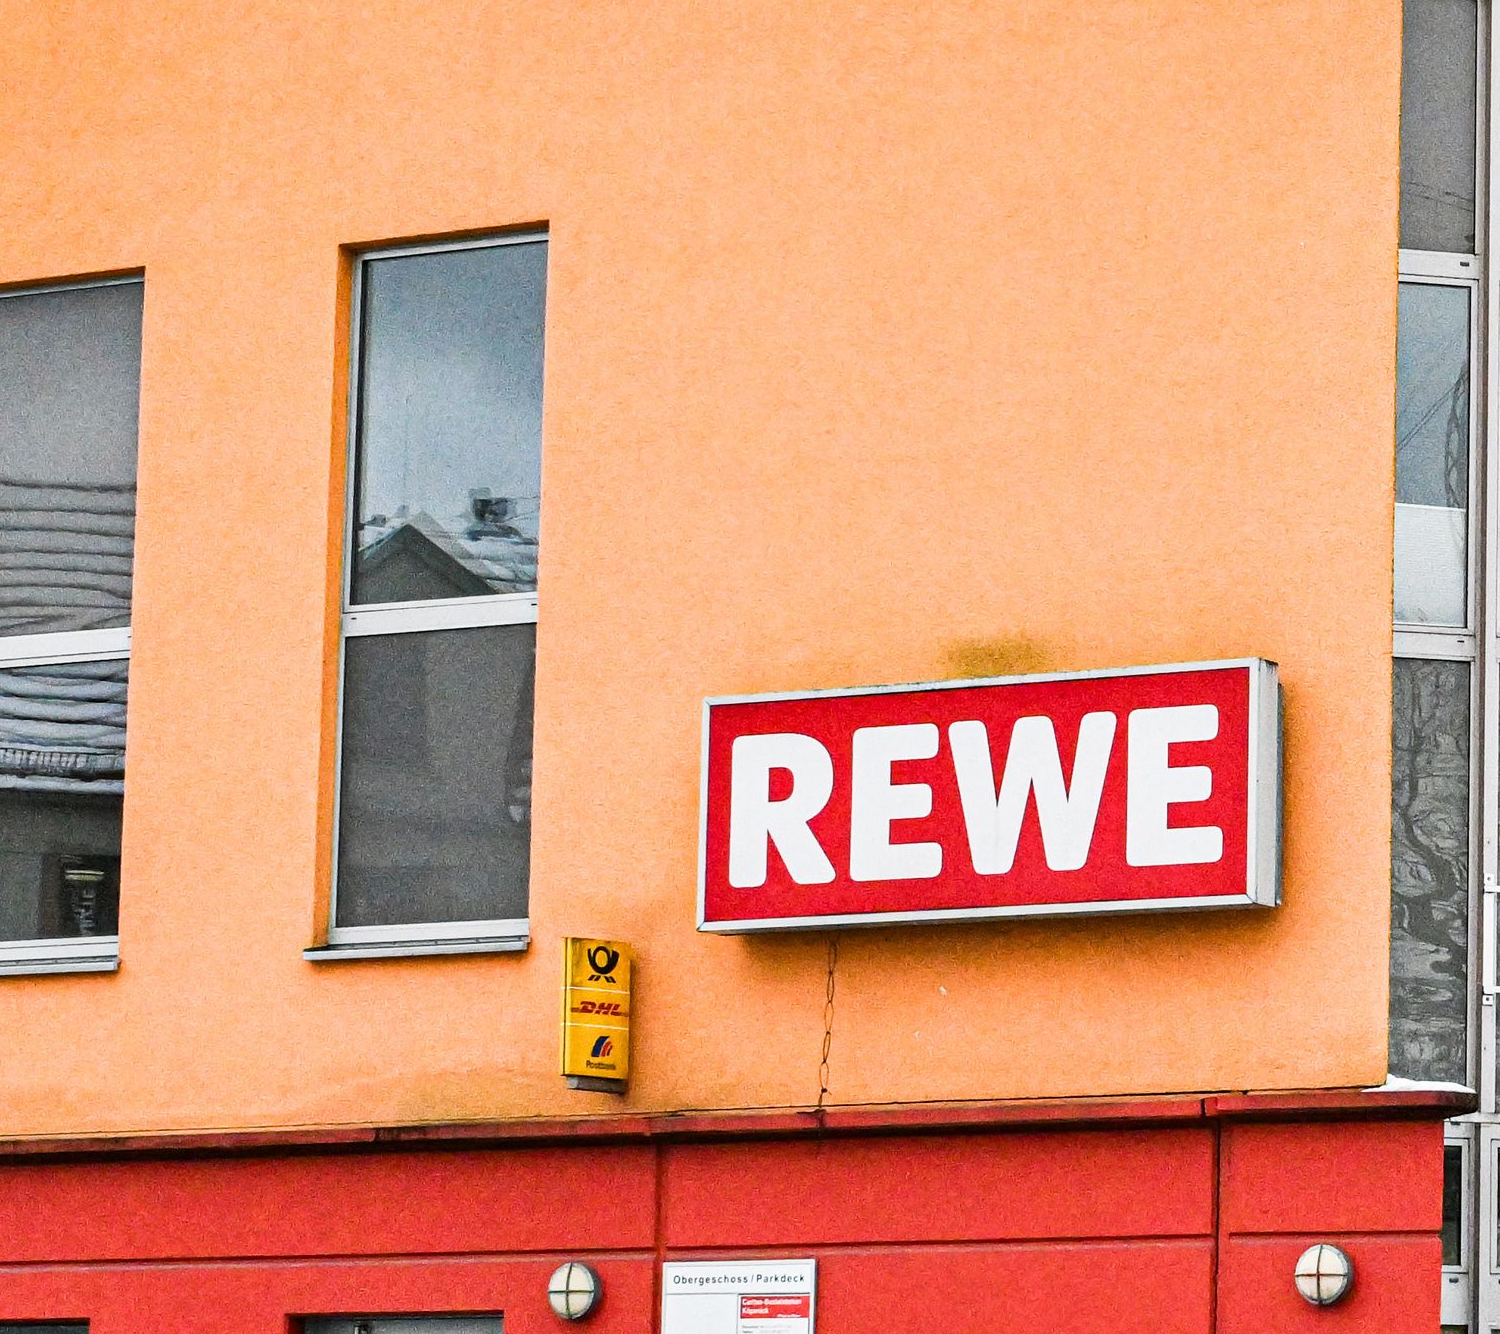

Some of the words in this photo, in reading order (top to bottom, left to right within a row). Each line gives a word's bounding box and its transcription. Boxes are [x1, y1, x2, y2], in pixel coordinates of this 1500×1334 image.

[727, 703, 1225, 889] REWE
[578, 1000, 624, 1016] DHL
[673, 1275, 749, 1286] Obergeschoss
[756, 1274, 805, 1283] Parkdeck
